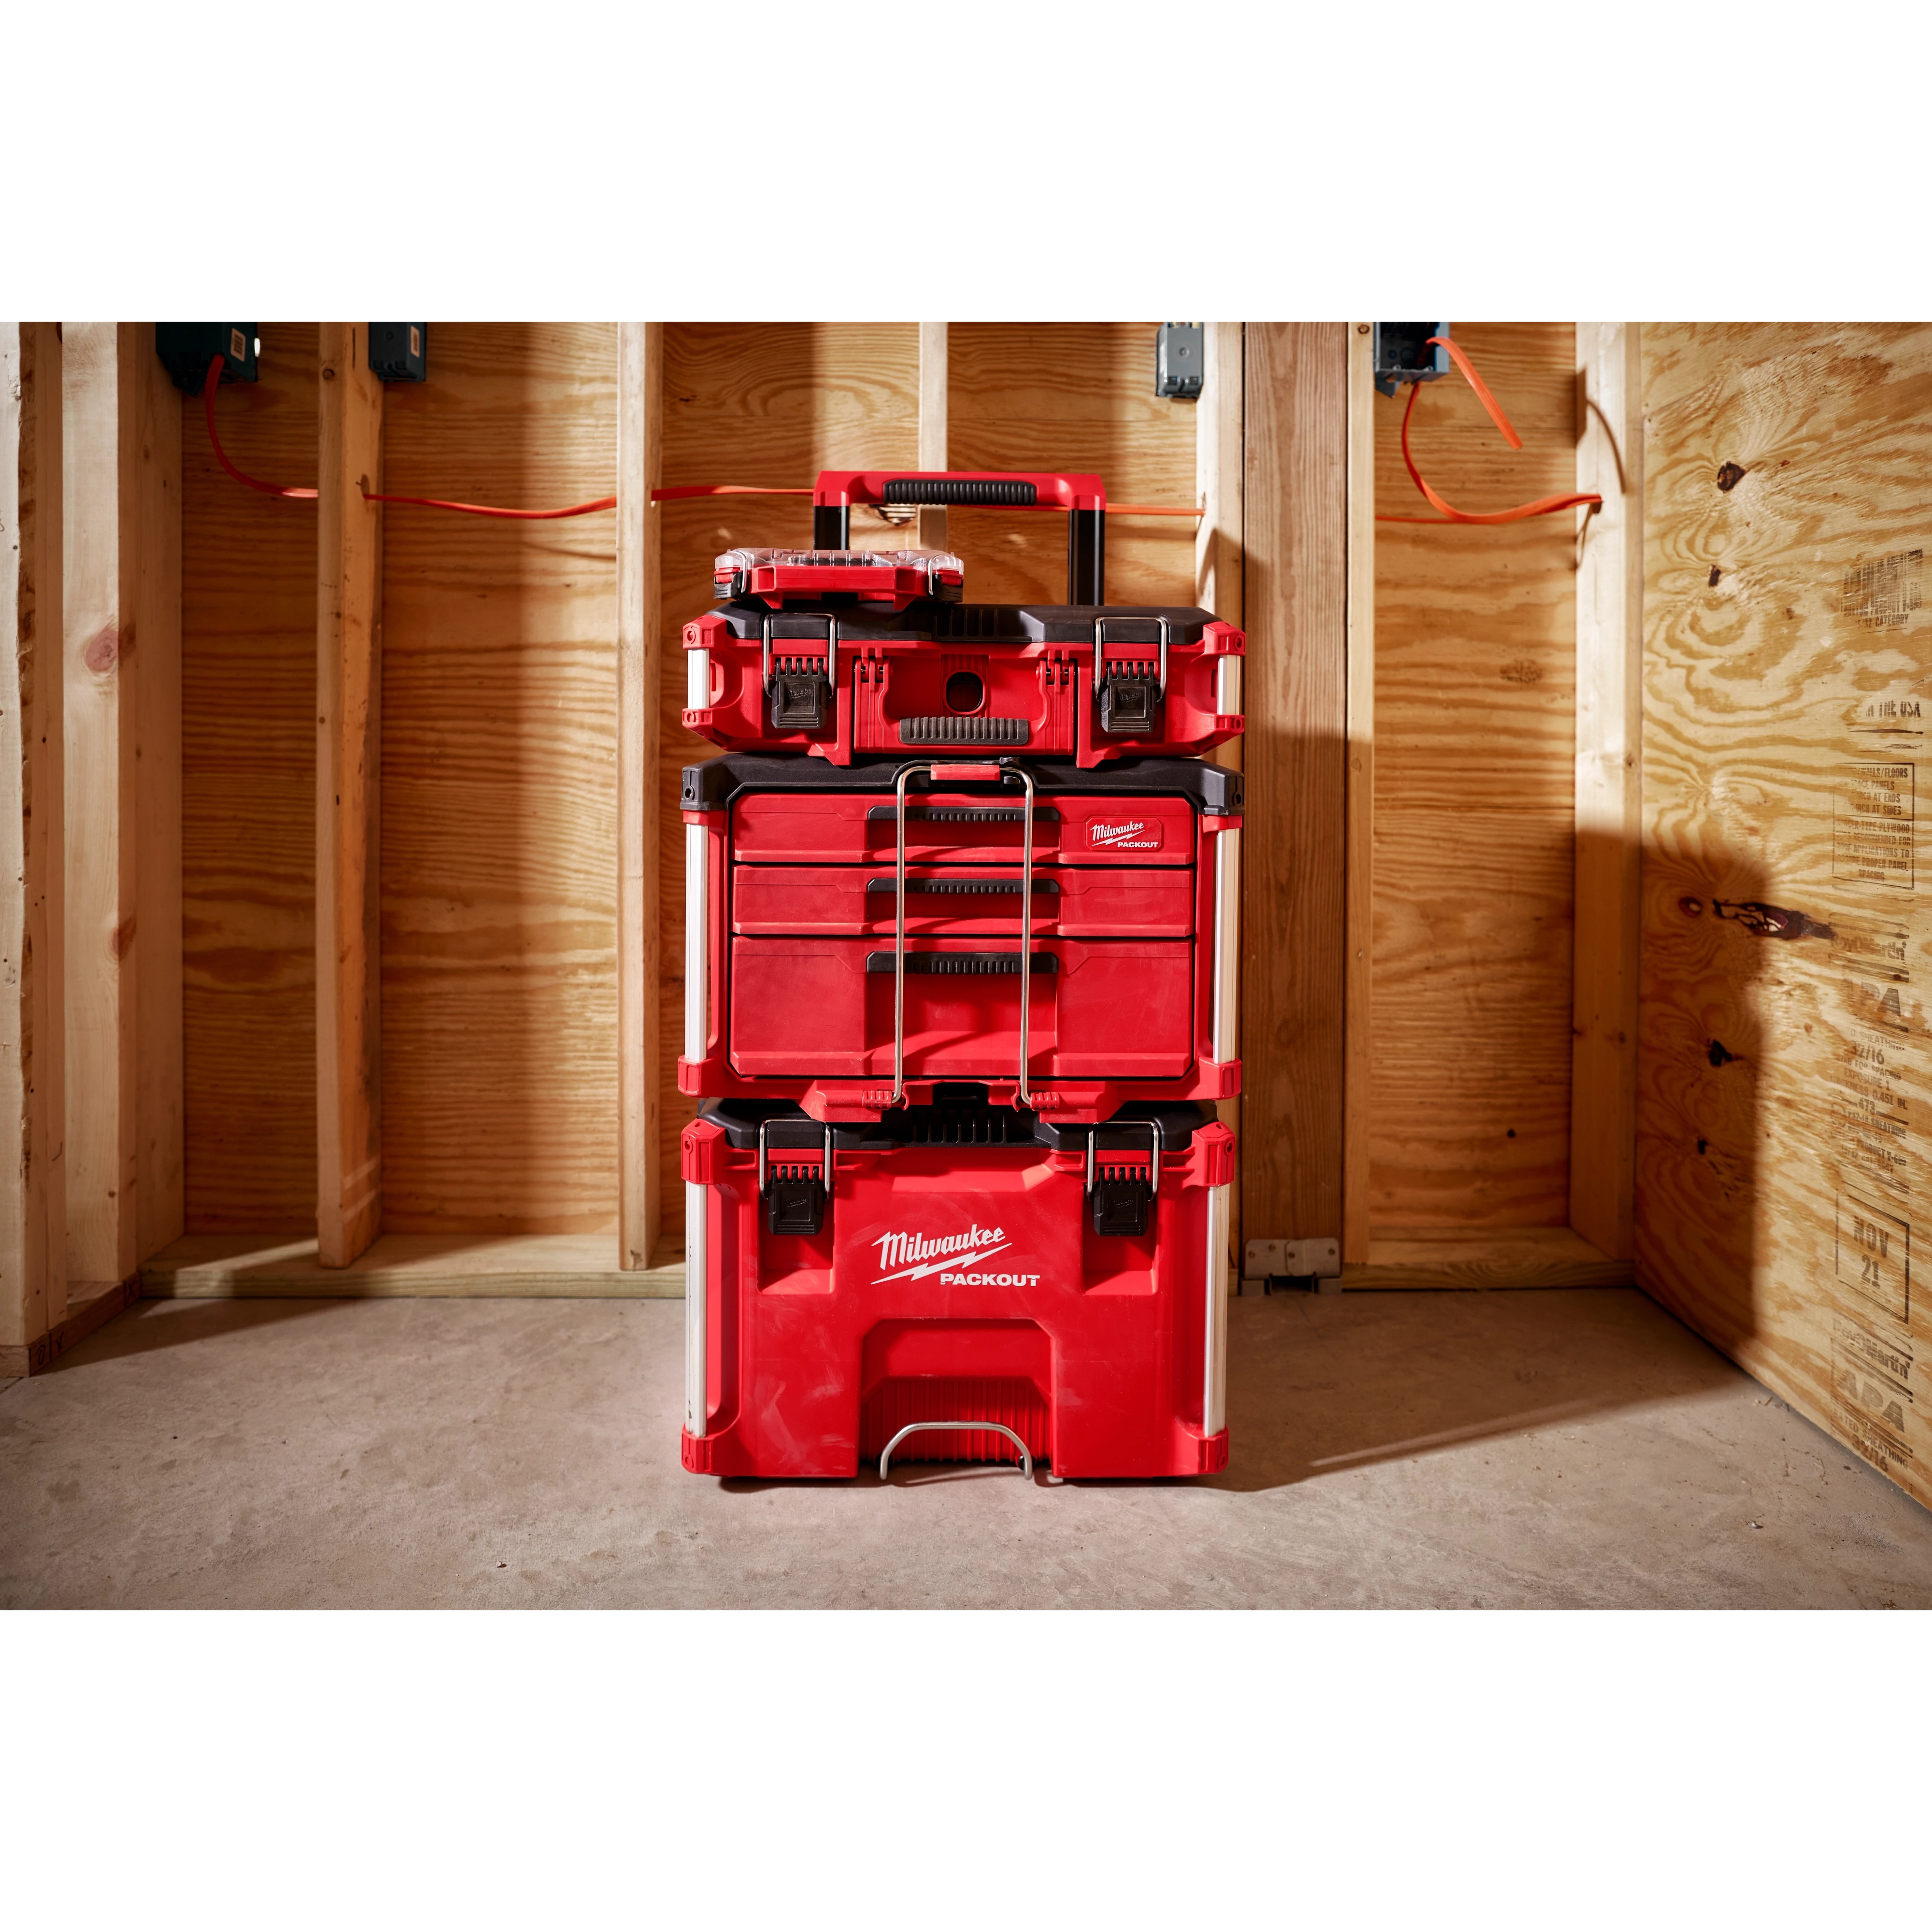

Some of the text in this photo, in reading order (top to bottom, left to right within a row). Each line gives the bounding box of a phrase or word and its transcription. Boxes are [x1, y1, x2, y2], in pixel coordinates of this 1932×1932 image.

[1871, 780, 1895, 791] PANELS
[1884, 793, 1901, 803] ENDS
[1872, 804, 1880, 814] AT
[1883, 805, 1902, 815] SIDES
[1090, 821, 1145, 841] Milwaukee
[1879, 822, 1910, 833] PLYWOOD
[1899, 836, 1911, 846] FOR
[1901, 849, 1910, 858] TO
[1862, 857, 1886, 869] PROPER
[1889, 860, 1908, 871] PANEL
[1854, 1215, 1889, 1258] NOV
[871, 1224, 1006, 1270] Milwaukee
[1861, 1254, 1880, 1290] 21
[940, 1273, 1040, 1287] PACKOUT
